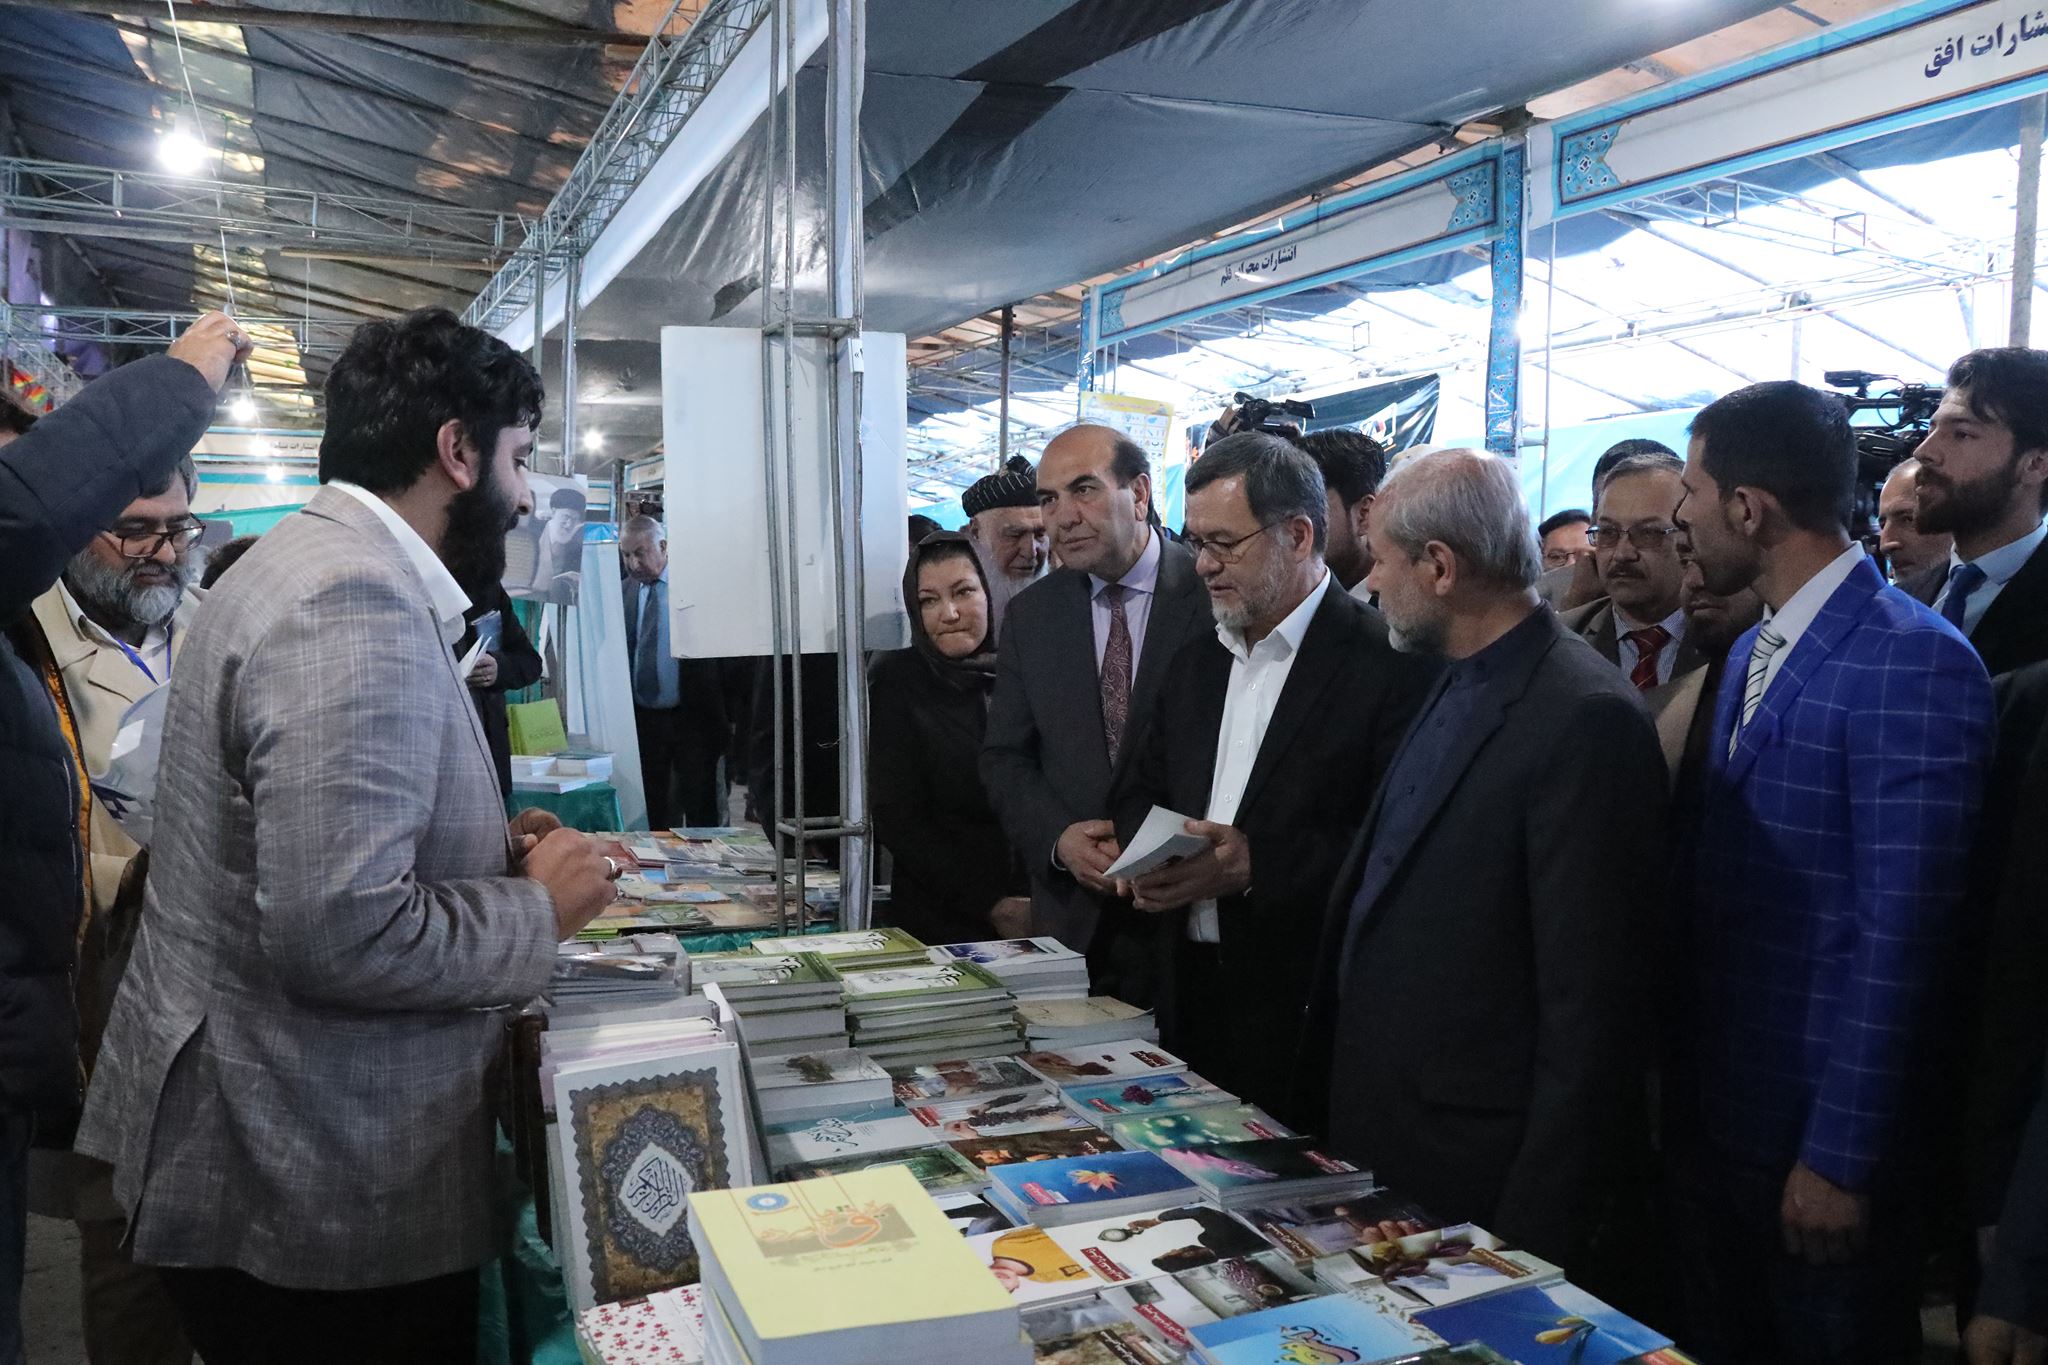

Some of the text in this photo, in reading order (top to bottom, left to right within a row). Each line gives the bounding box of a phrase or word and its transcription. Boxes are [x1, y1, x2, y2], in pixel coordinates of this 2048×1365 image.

[1924, 10, 2048, 78] شارات افق
[1261, 244, 1297, 272] انتشارات
[1220, 264, 1233, 287] قلم
